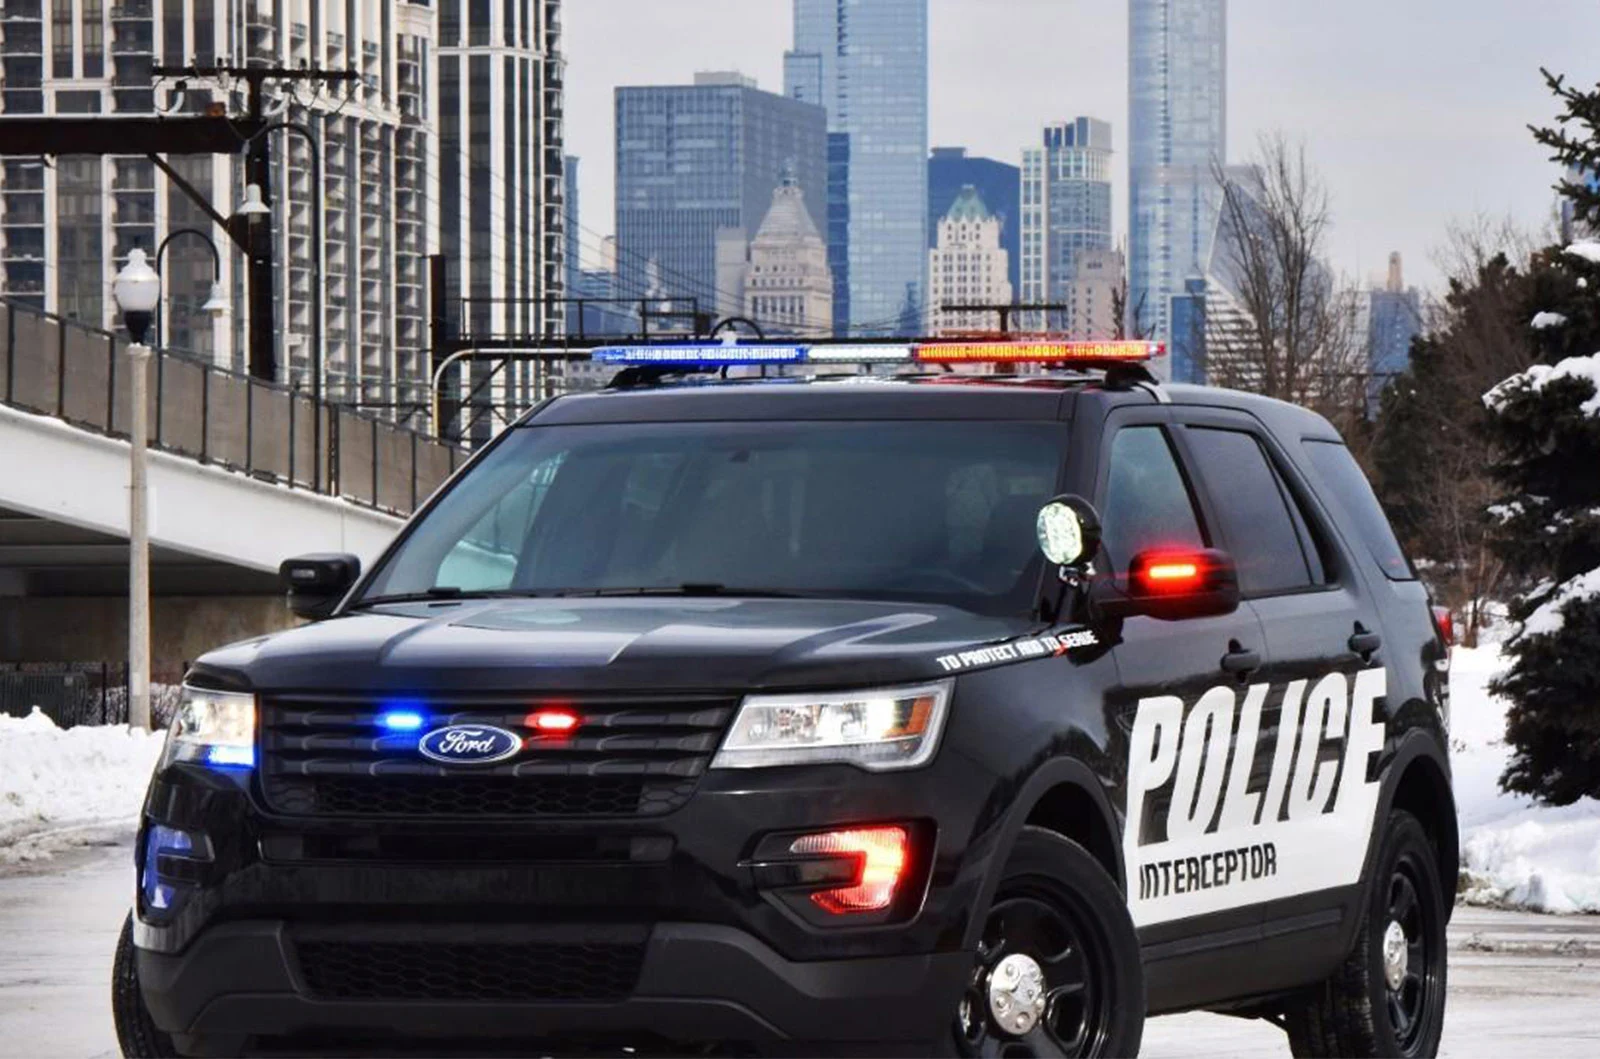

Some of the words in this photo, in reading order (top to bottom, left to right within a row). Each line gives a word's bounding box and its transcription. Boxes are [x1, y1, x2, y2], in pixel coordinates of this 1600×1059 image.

[936, 654, 962, 671] TO
[958, 643, 1018, 668] PROTECT
[1015, 639, 1044, 656] AND
[1040, 635, 1060, 652] TO
[438, 729, 496, 753] Ford
[1124, 667, 1387, 848] POLICE
[1139, 842, 1277, 900] INTERCEPTOR
